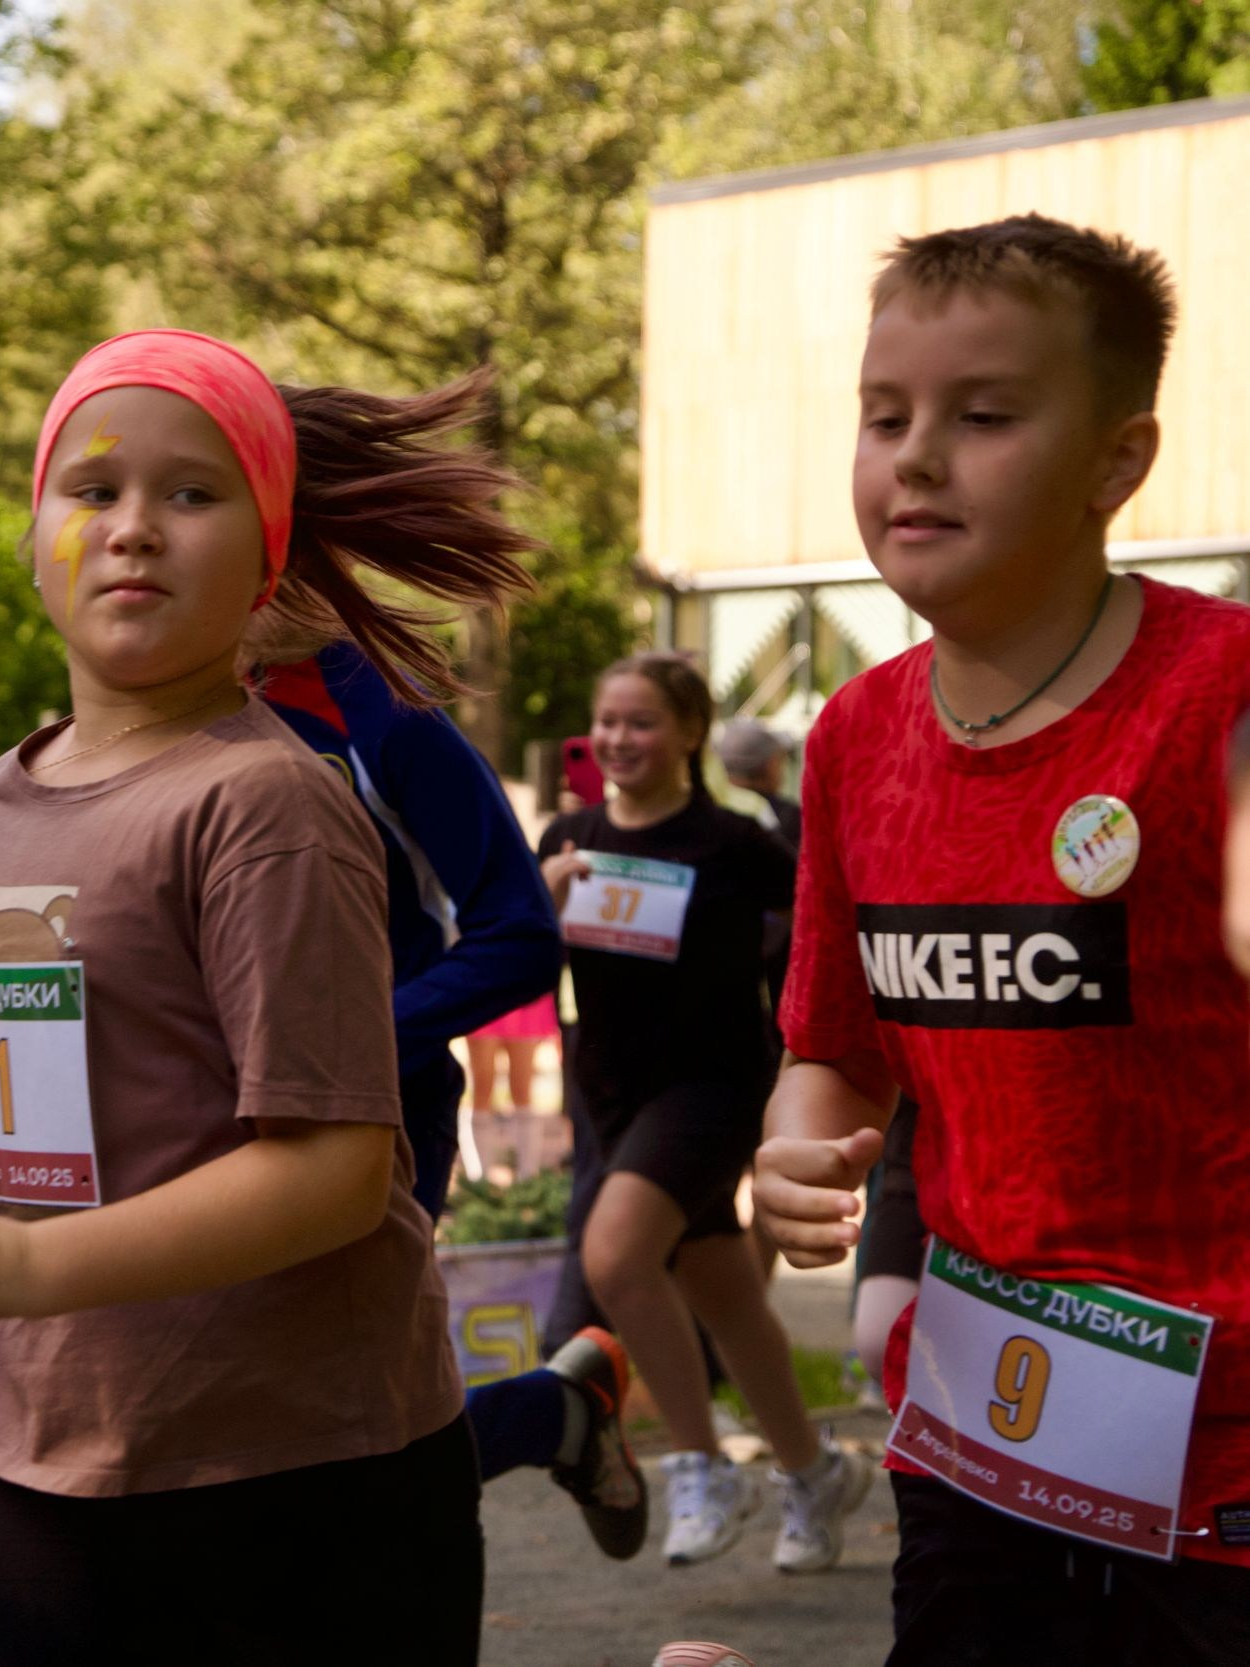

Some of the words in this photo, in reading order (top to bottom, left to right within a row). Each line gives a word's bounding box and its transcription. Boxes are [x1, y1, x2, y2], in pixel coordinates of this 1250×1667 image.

[599, 884, 644, 924] 37
[857, 931, 975, 1000] NIKE
[981, 932, 1101, 1003] F.C.
[8, 1165, 75, 1187] 14.09.25
[945, 1249, 1041, 1306] КРОСС
[1043, 1288, 1169, 1352] ДУБКИ
[988, 1335, 1052, 1442] 9
[1018, 1479, 1135, 1532] 14.09.25
